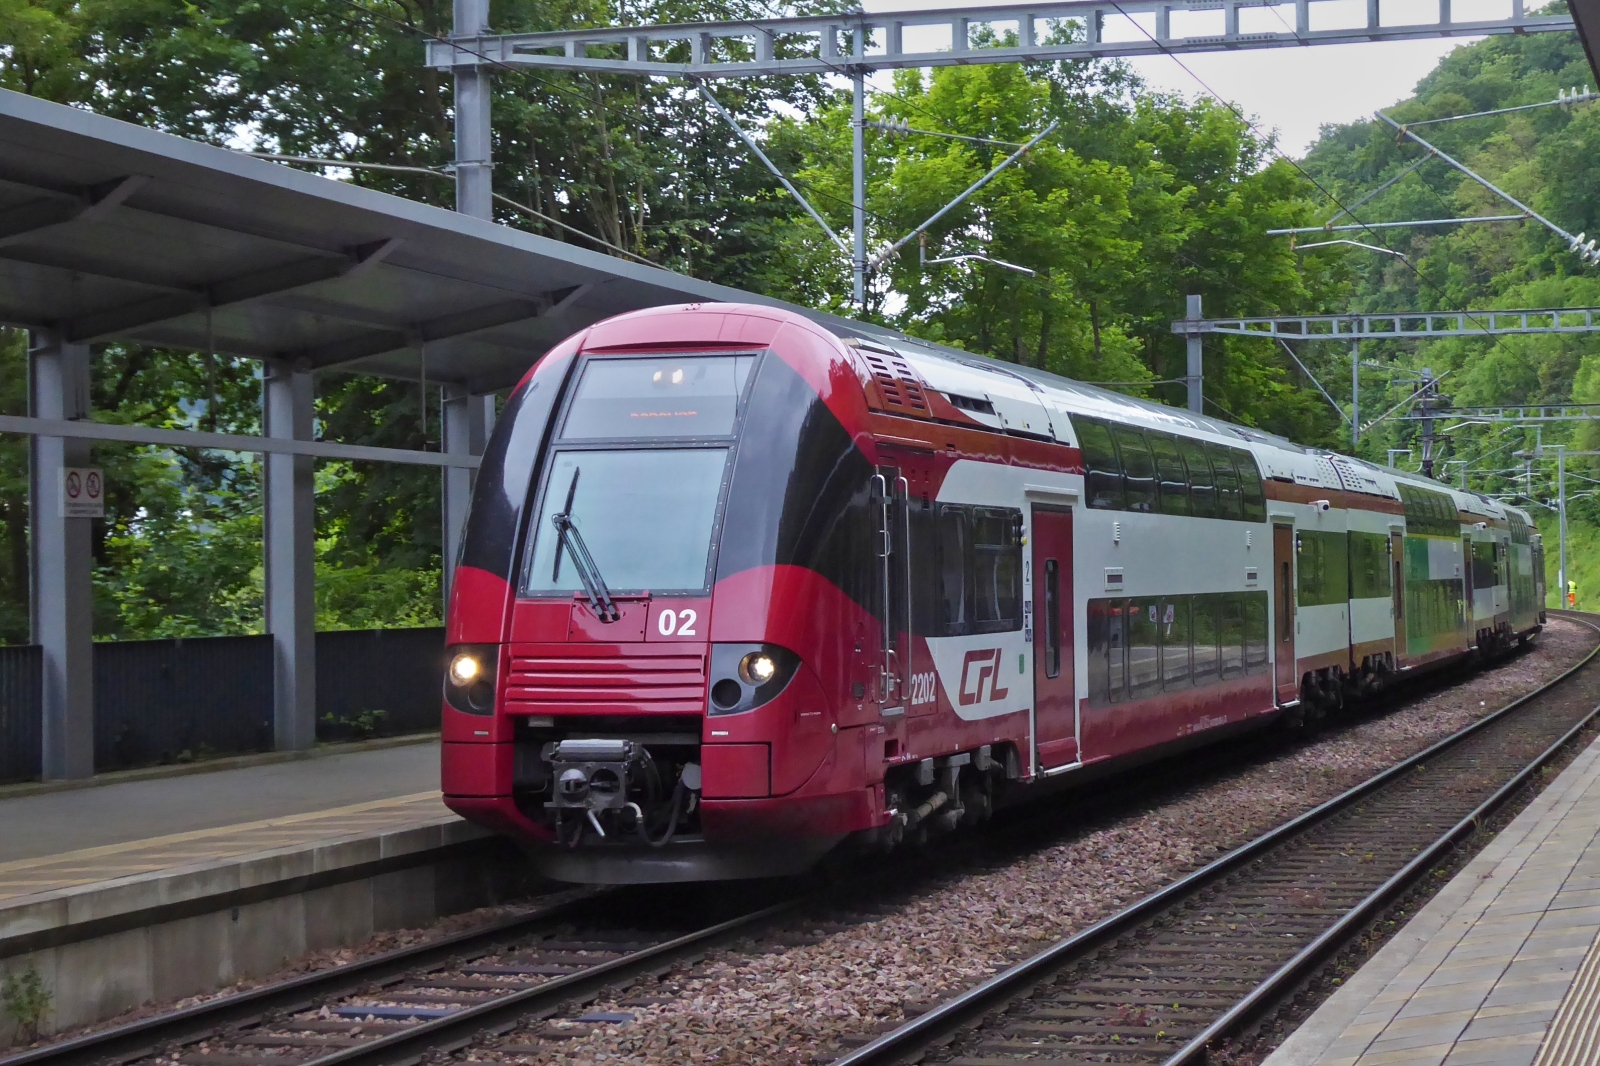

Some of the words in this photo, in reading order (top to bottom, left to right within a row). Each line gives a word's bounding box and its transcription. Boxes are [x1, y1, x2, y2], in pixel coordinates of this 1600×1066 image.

[658, 608, 697, 636] 02
[911, 671, 936, 705] 2202
[959, 647, 1009, 706] CFL
